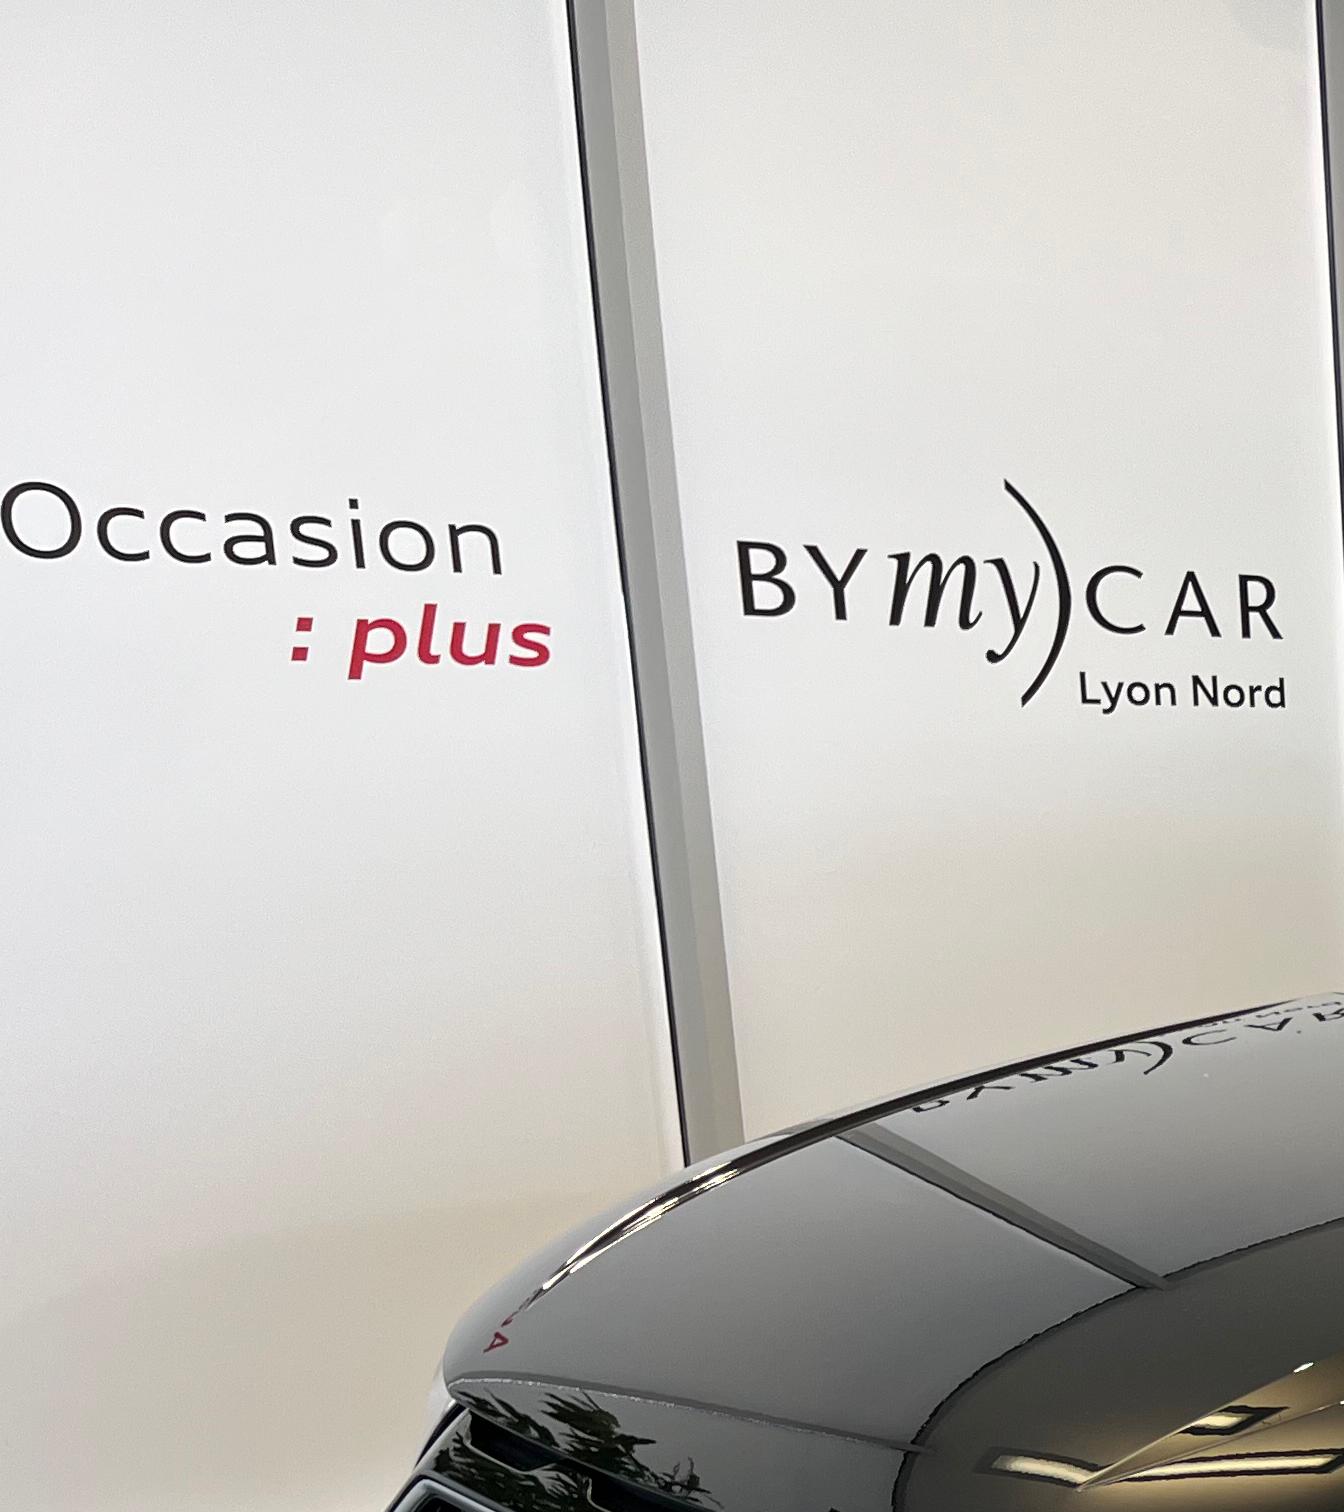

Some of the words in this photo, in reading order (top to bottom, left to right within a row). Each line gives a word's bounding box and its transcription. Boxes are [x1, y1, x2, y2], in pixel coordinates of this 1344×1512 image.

[1, 481, 502, 575] Occasion
[1079, 671, 1178, 715] Lyon
[1192, 675, 1287, 709] Nord
